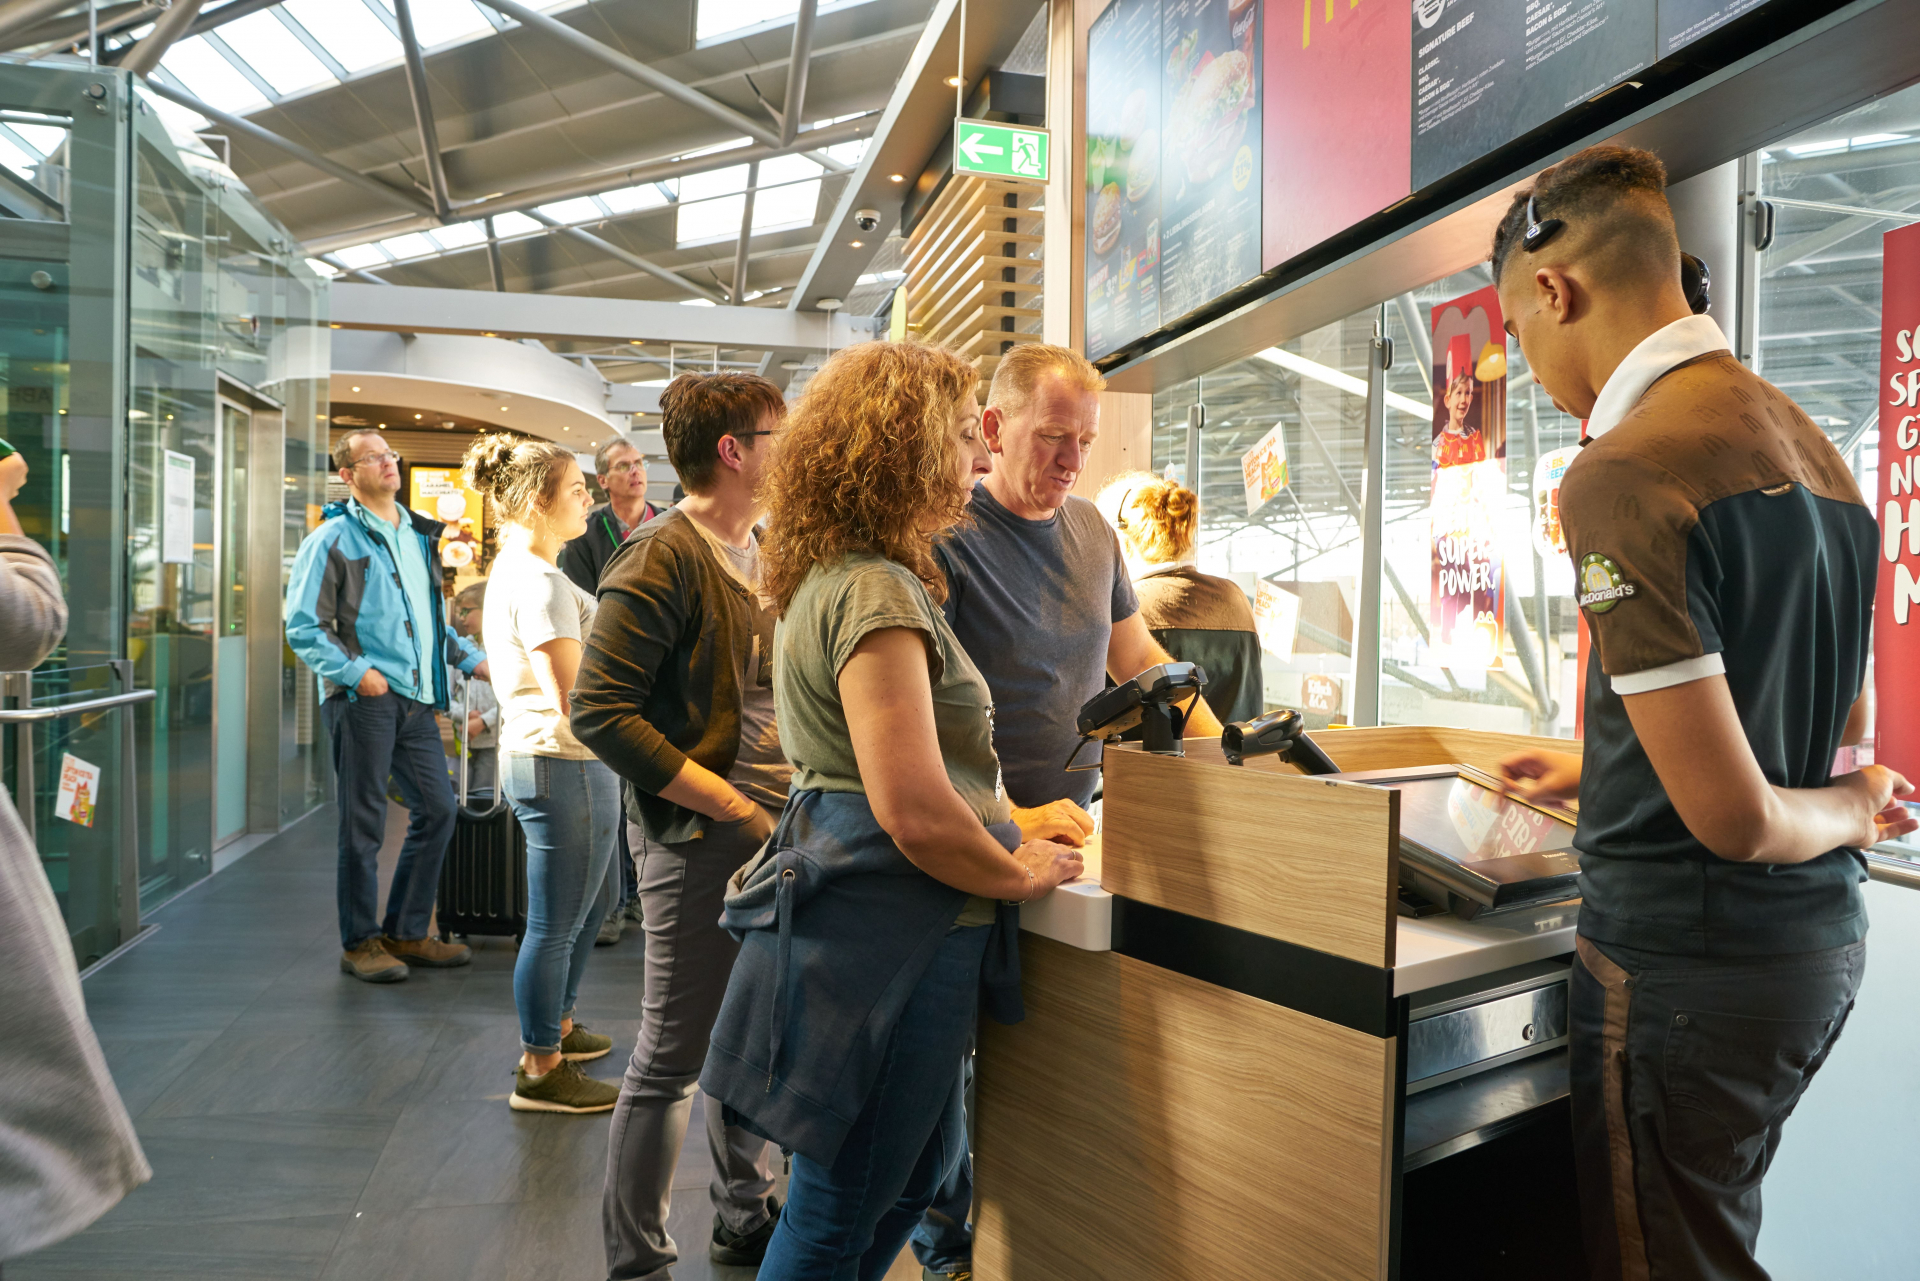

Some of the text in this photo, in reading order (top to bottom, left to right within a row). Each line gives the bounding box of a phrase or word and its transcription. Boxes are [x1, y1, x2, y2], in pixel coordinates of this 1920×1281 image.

[1418, 11, 1475, 58] SIGNATURE BEEF
[1526, 17, 1548, 37] BACON
[1548, 14, 1553, 22] &
[1418, 90, 1435, 106] BACON
[1580, 583, 1635, 607] McDonald's
